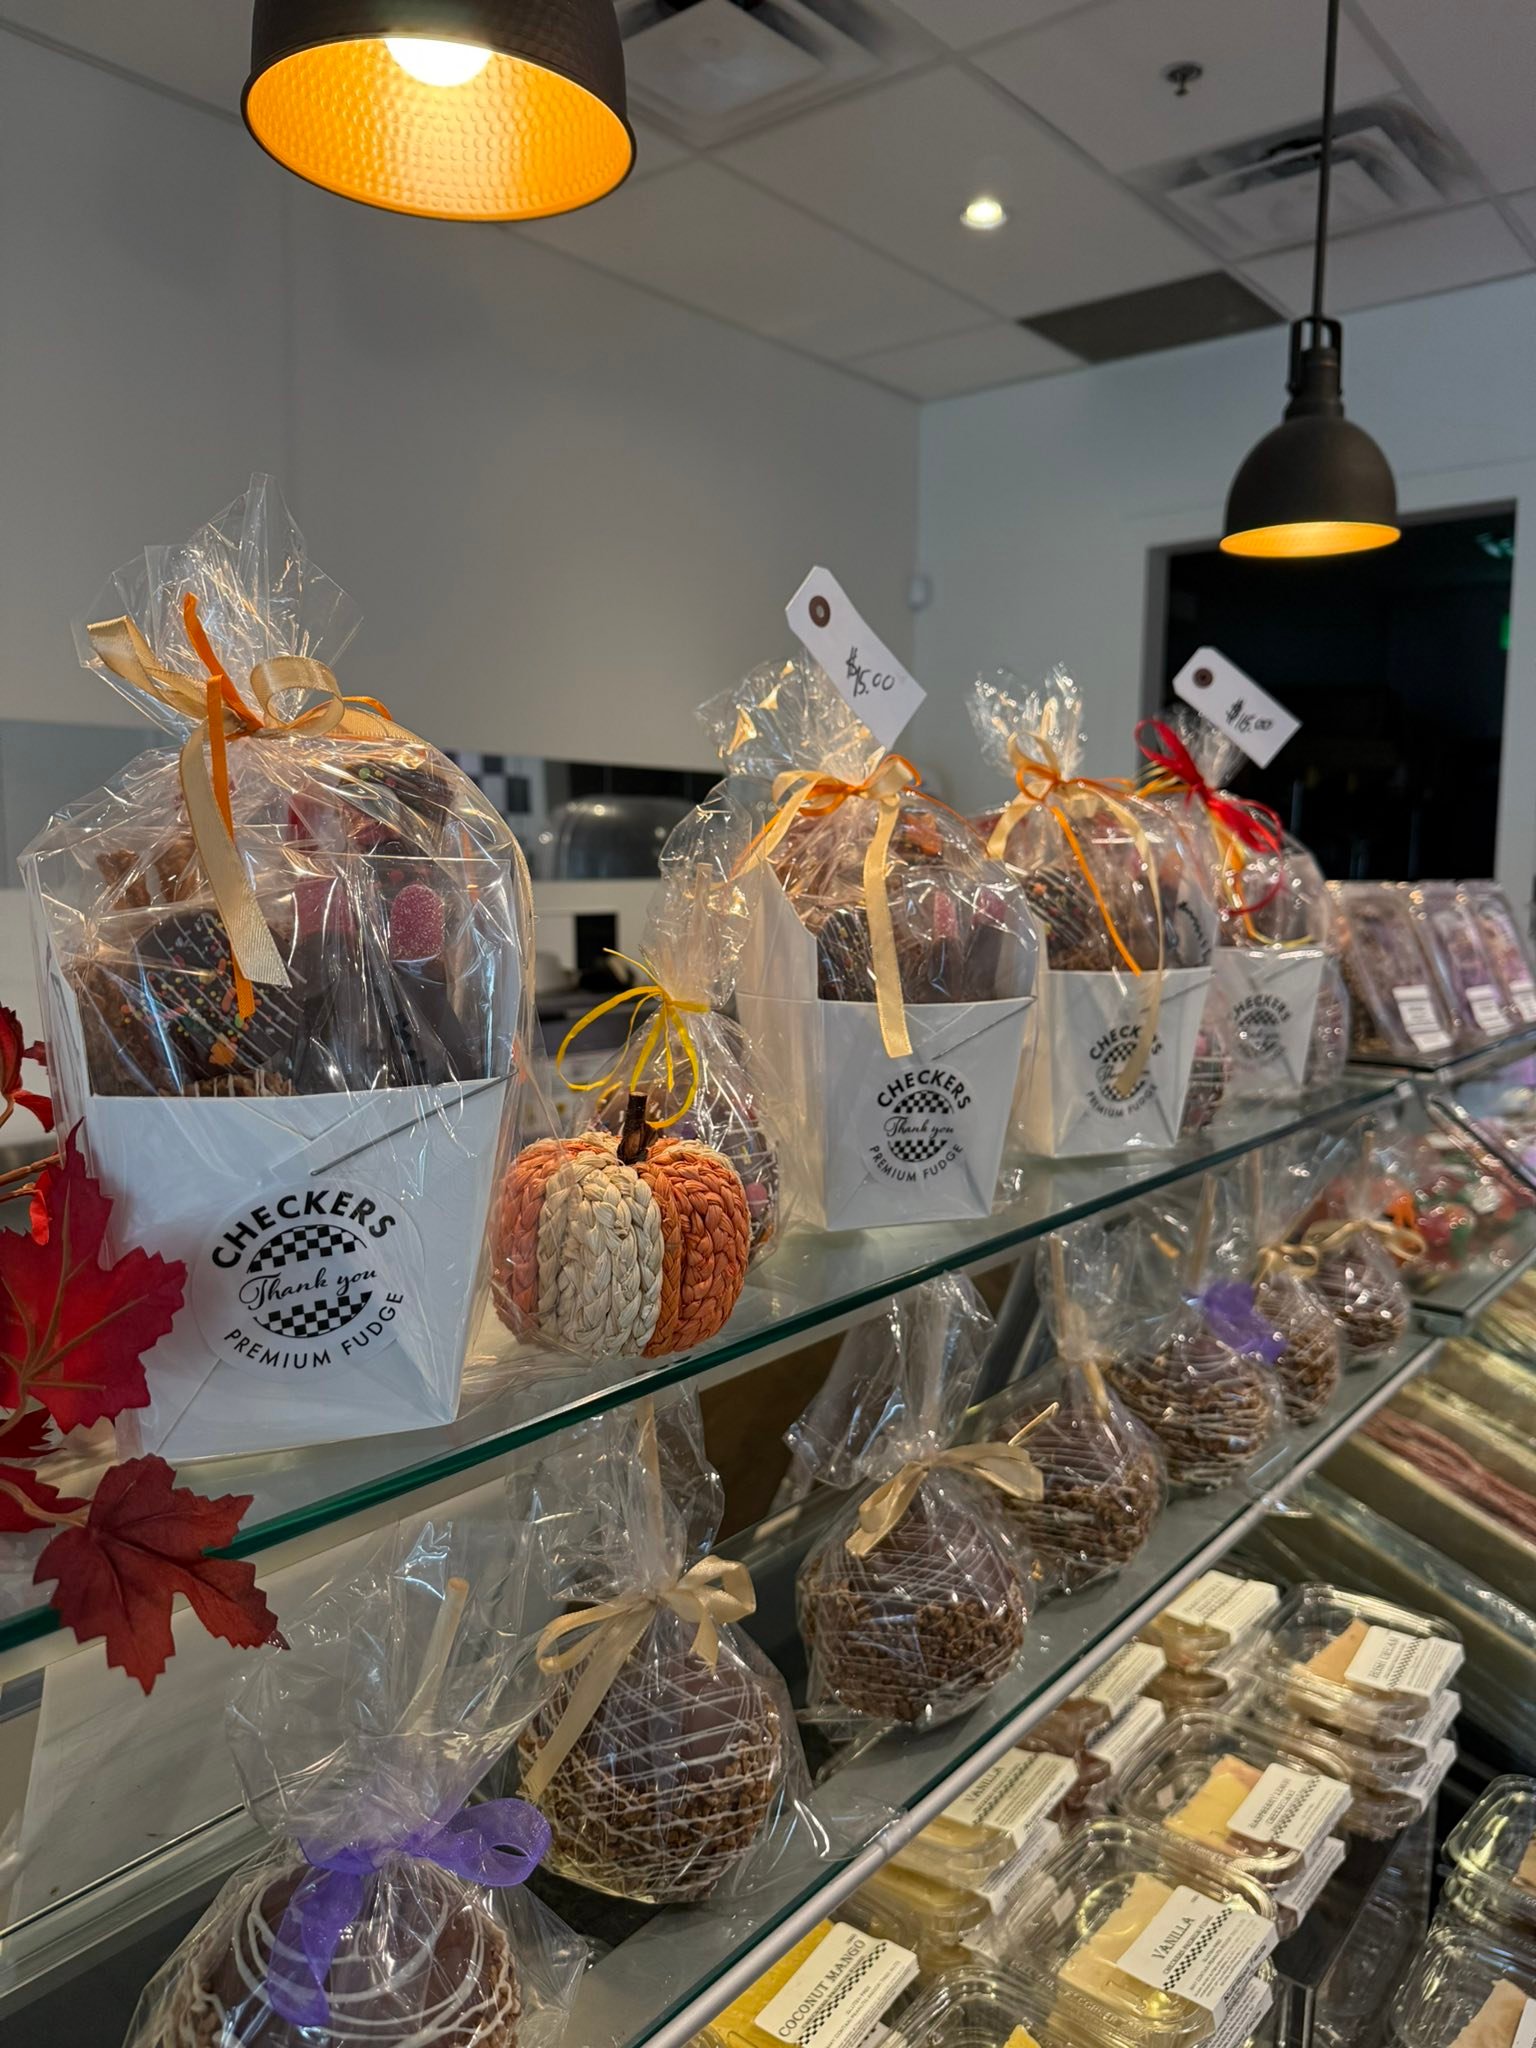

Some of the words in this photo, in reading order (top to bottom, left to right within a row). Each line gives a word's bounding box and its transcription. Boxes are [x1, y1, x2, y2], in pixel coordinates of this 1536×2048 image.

[845, 647, 896, 697] $15.00
[1090, 1024, 1163, 1059] CHECKS
[877, 1069, 971, 1109] CHECKERS
[884, 1116, 930, 1137] Thank
[929, 1126, 954, 1140] you
[869, 1145, 917, 1182] PREMIUM
[923, 1144, 963, 1180] FUDGE
[212, 1190, 396, 1268] CHECKERS
[239, 1267, 328, 1311] Thank
[336, 1269, 377, 1297] you
[224, 1329, 331, 1370] PREMIUM
[341, 1292, 404, 1355] FUDGE
[962, 1762, 1004, 1805] VANILLA
[1151, 1917, 1195, 1960] VANILLA
[778, 1981, 829, 2037] COCONUT
[825, 1939, 866, 1984] MANGO
